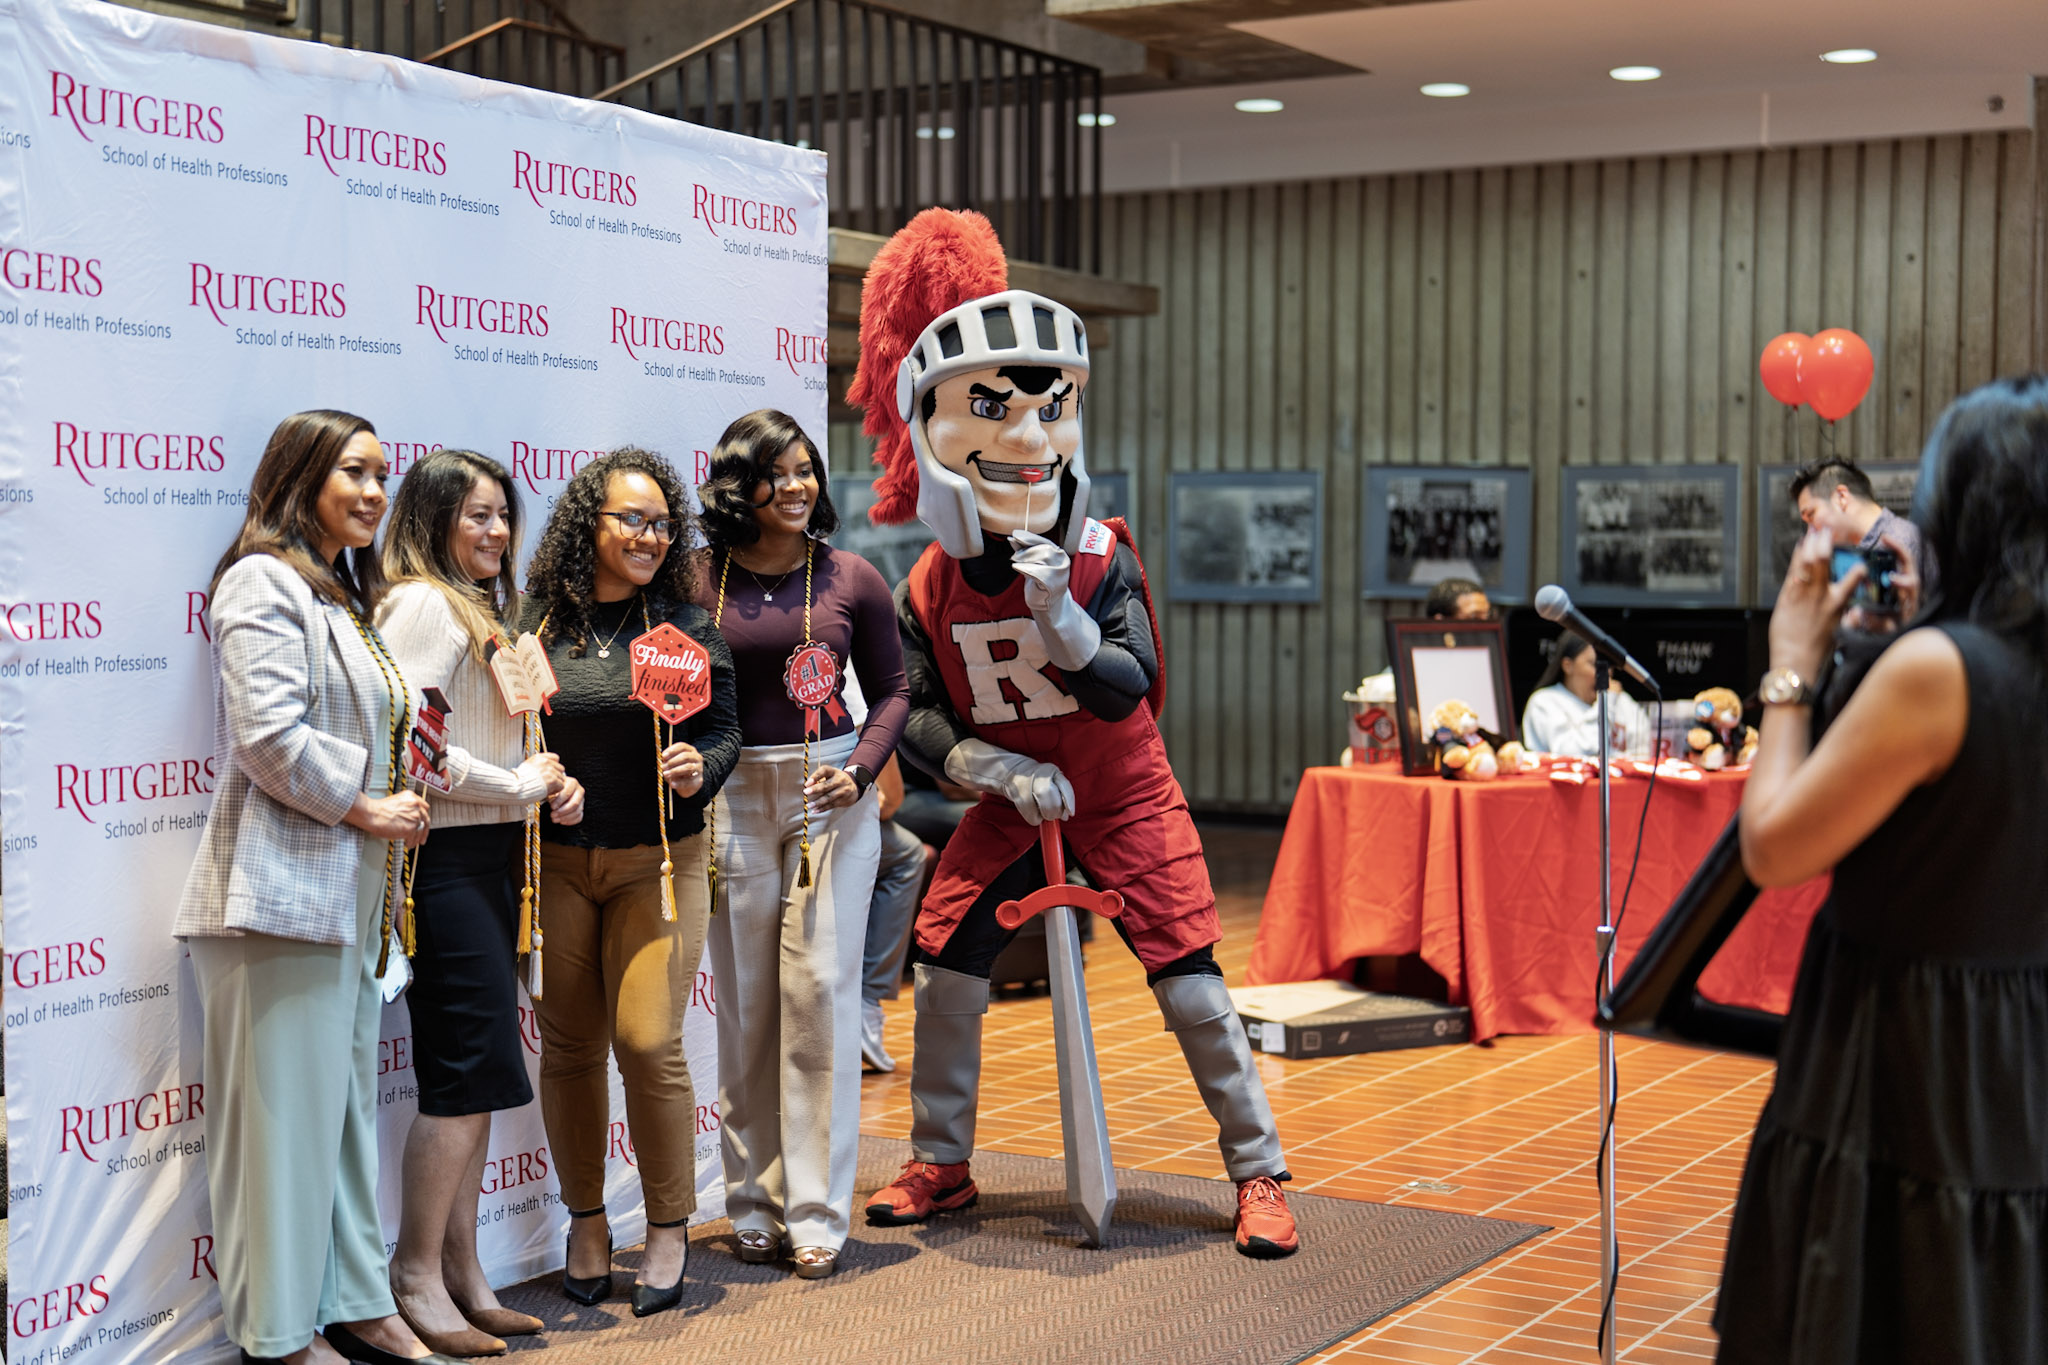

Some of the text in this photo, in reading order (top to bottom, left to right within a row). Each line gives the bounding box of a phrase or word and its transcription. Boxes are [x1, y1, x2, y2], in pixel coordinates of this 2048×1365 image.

[48, 70, 224, 144] RUTGERS
[304, 114, 446, 177] RUTGERS
[102, 146, 288, 187] School of Health Professions
[512, 150, 637, 208] RUTGERS
[346, 178, 500, 216] School of Health Professions
[692, 184, 796, 237] RUTGERS
[550, 210, 682, 244] School of Health Professions
[724, 239, 828, 266] School of Health Professio
[0, 248, 102, 297] GERS
[188, 262, 346, 326] RUTGERS
[24, 309, 38, 327] of
[44, 311, 90, 332] Health
[96, 313, 171, 339] Professions
[416, 284, 549, 344] RUTGERS
[610, 306, 724, 360] RUTGERS
[236, 328, 402, 356] School of Health Professions
[454, 345, 598, 372] School of Health Professions
[644, 362, 766, 388] School of Health Professions
[804, 376, 827, 391] Schoo
[52, 421, 224, 486] RUTGERS
[104, 488, 148, 505] School
[154, 488, 166, 505] of
[172, 488, 212, 506] Health
[0, 600, 102, 642] GERS
[1, 654, 168, 677] ool of Health Professions
[634, 644, 705, 682] Finally
[801, 653, 822, 682] #1
[1658, 641, 1712, 657] THANK
[1667, 658, 1701, 674] YOU
[633, 669, 708, 696] finished
[798, 674, 833, 698] GRAD
[951, 616, 1080, 725] R
[104, 810, 208, 840] School of Health
[4, 937, 106, 989] GERS
[6, 982, 170, 1028] ool of Health Professions
[58, 1083, 204, 1163] RUTGER
[106, 1136, 205, 1175] School of Heal
[480, 1147, 548, 1194] GERS
[494, 1205, 504, 1222] of
[508, 1195, 540, 1218] Health
[7, 1274, 109, 1338] GERS
[50, 1334, 92, 1364] Health
[98, 1308, 174, 1344] Professions
